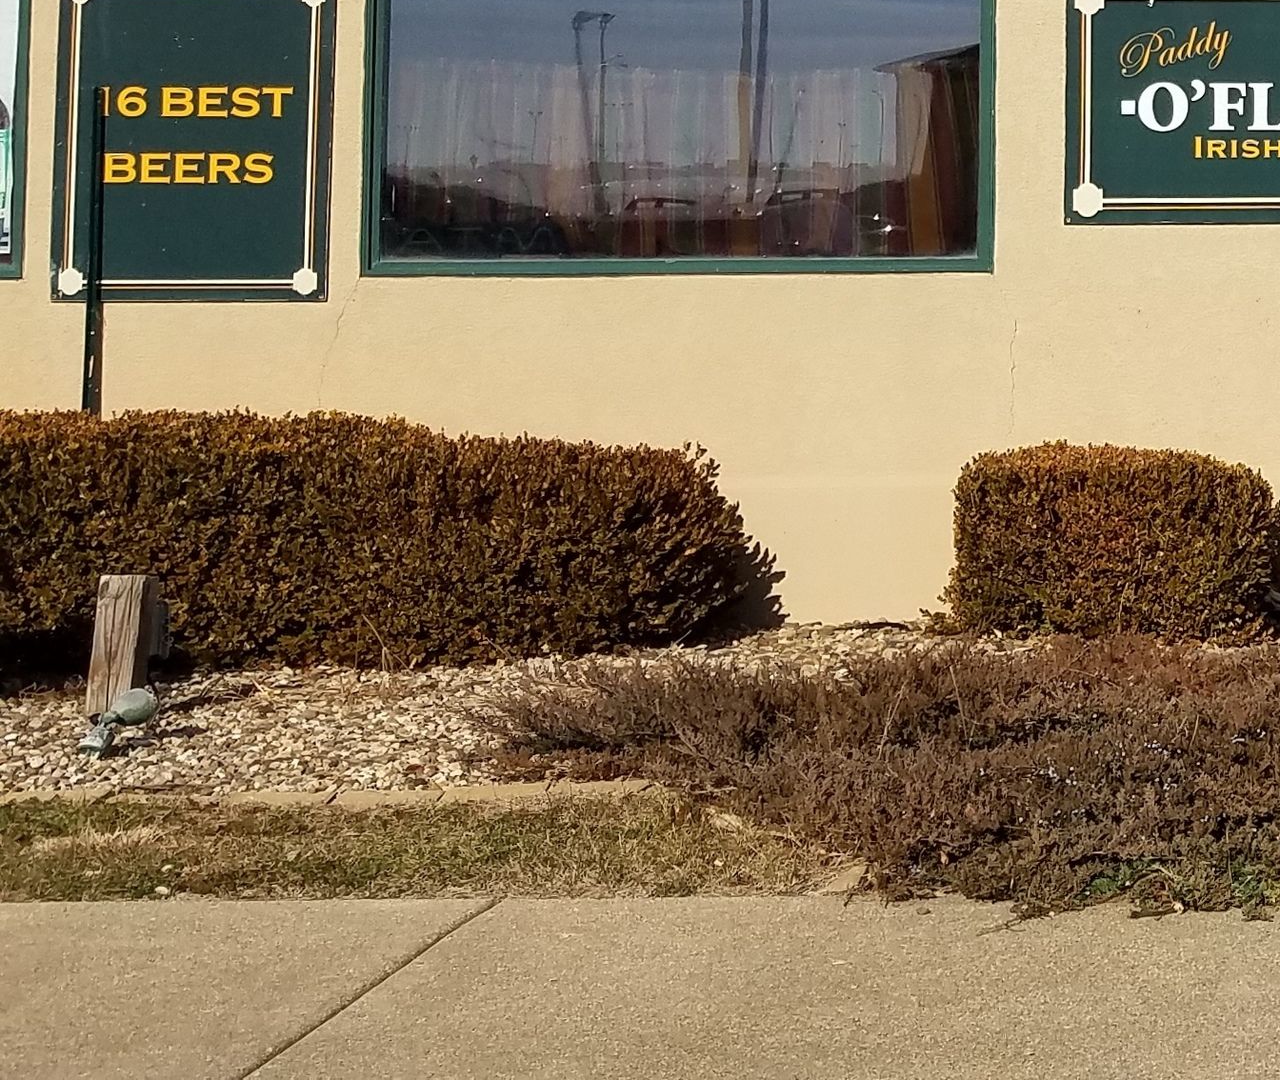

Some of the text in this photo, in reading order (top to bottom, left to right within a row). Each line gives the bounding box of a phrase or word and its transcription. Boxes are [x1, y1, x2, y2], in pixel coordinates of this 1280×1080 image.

[1119, 20, 1233, 78] Paddy
[160, 86, 295, 118] BEST
[102, 151, 275, 185] BEERS
